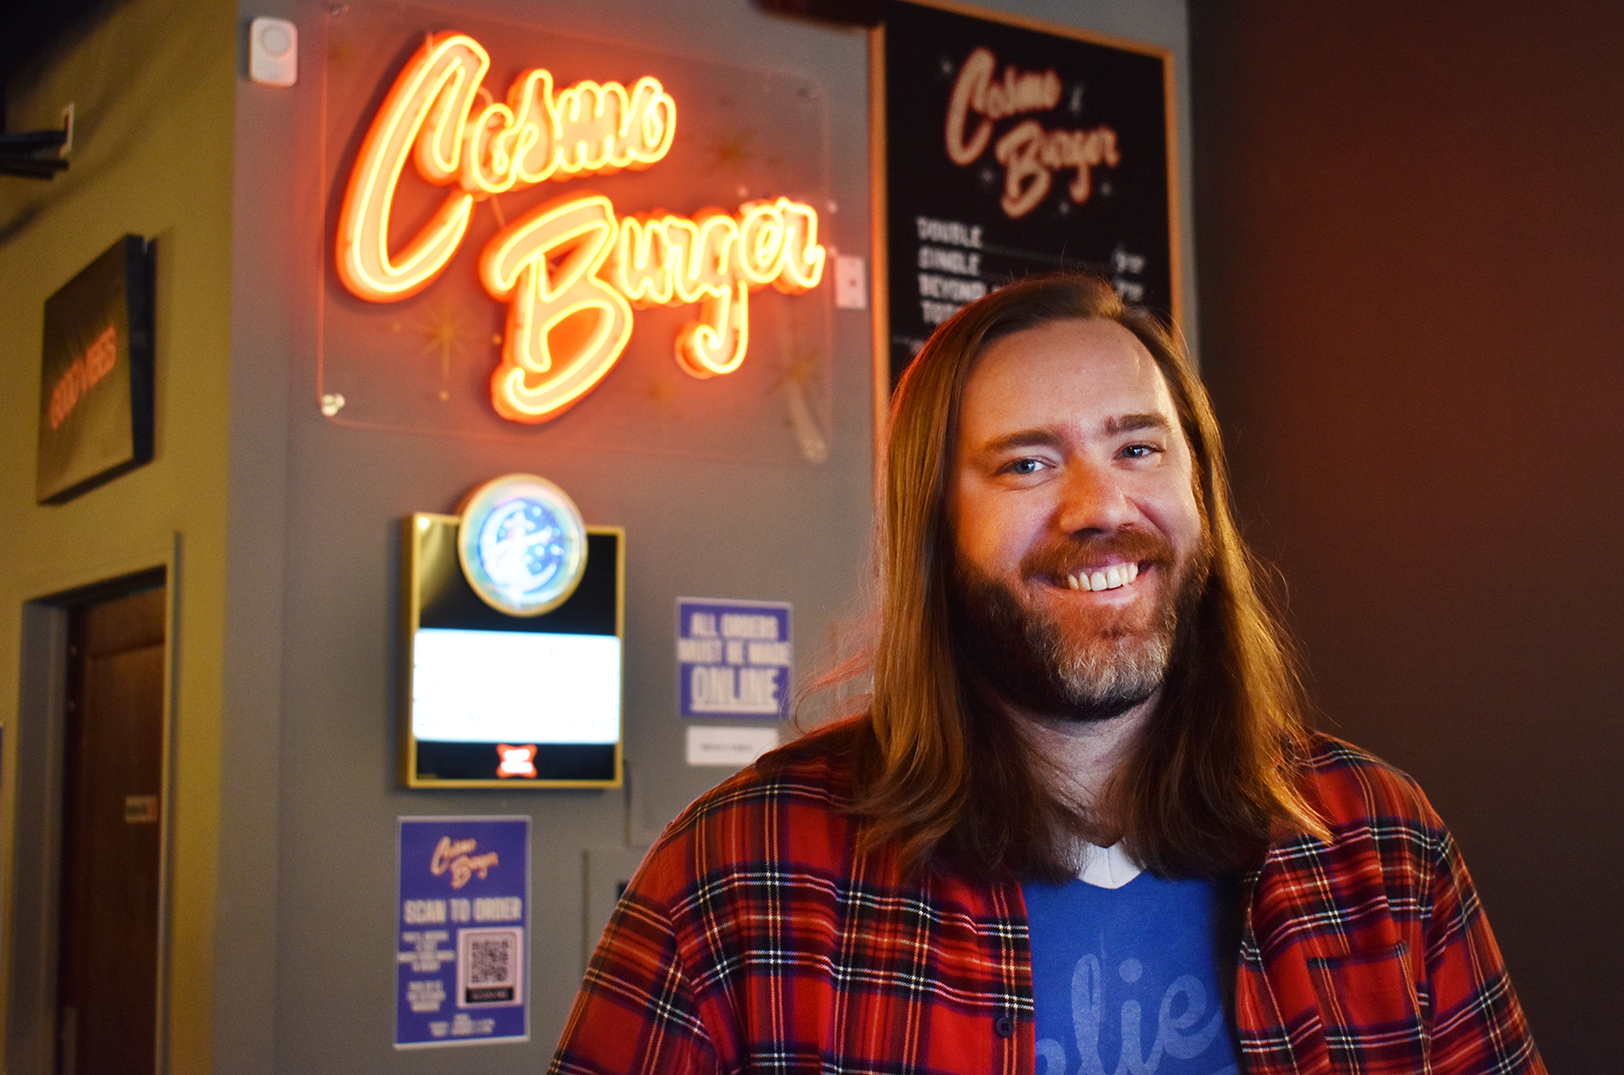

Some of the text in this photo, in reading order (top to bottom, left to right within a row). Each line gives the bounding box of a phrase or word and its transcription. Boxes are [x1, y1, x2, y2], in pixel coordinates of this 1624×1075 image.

[946, 47, 1061, 165] Cosmo
[339, 32, 676, 301] Cosmo
[996, 120, 1120, 219] Burger
[916, 216, 983, 248] DOUBLE
[918, 247, 981, 276] SINGLE
[481, 192, 825, 422] Burger
[690, 611, 780, 640] ALL ORDERS
[677, 638, 722, 664] MUST
[726, 640, 746, 665] BE
[690, 666, 779, 704] ONLINE
[404, 897, 523, 924] SCAN TO ORDER
